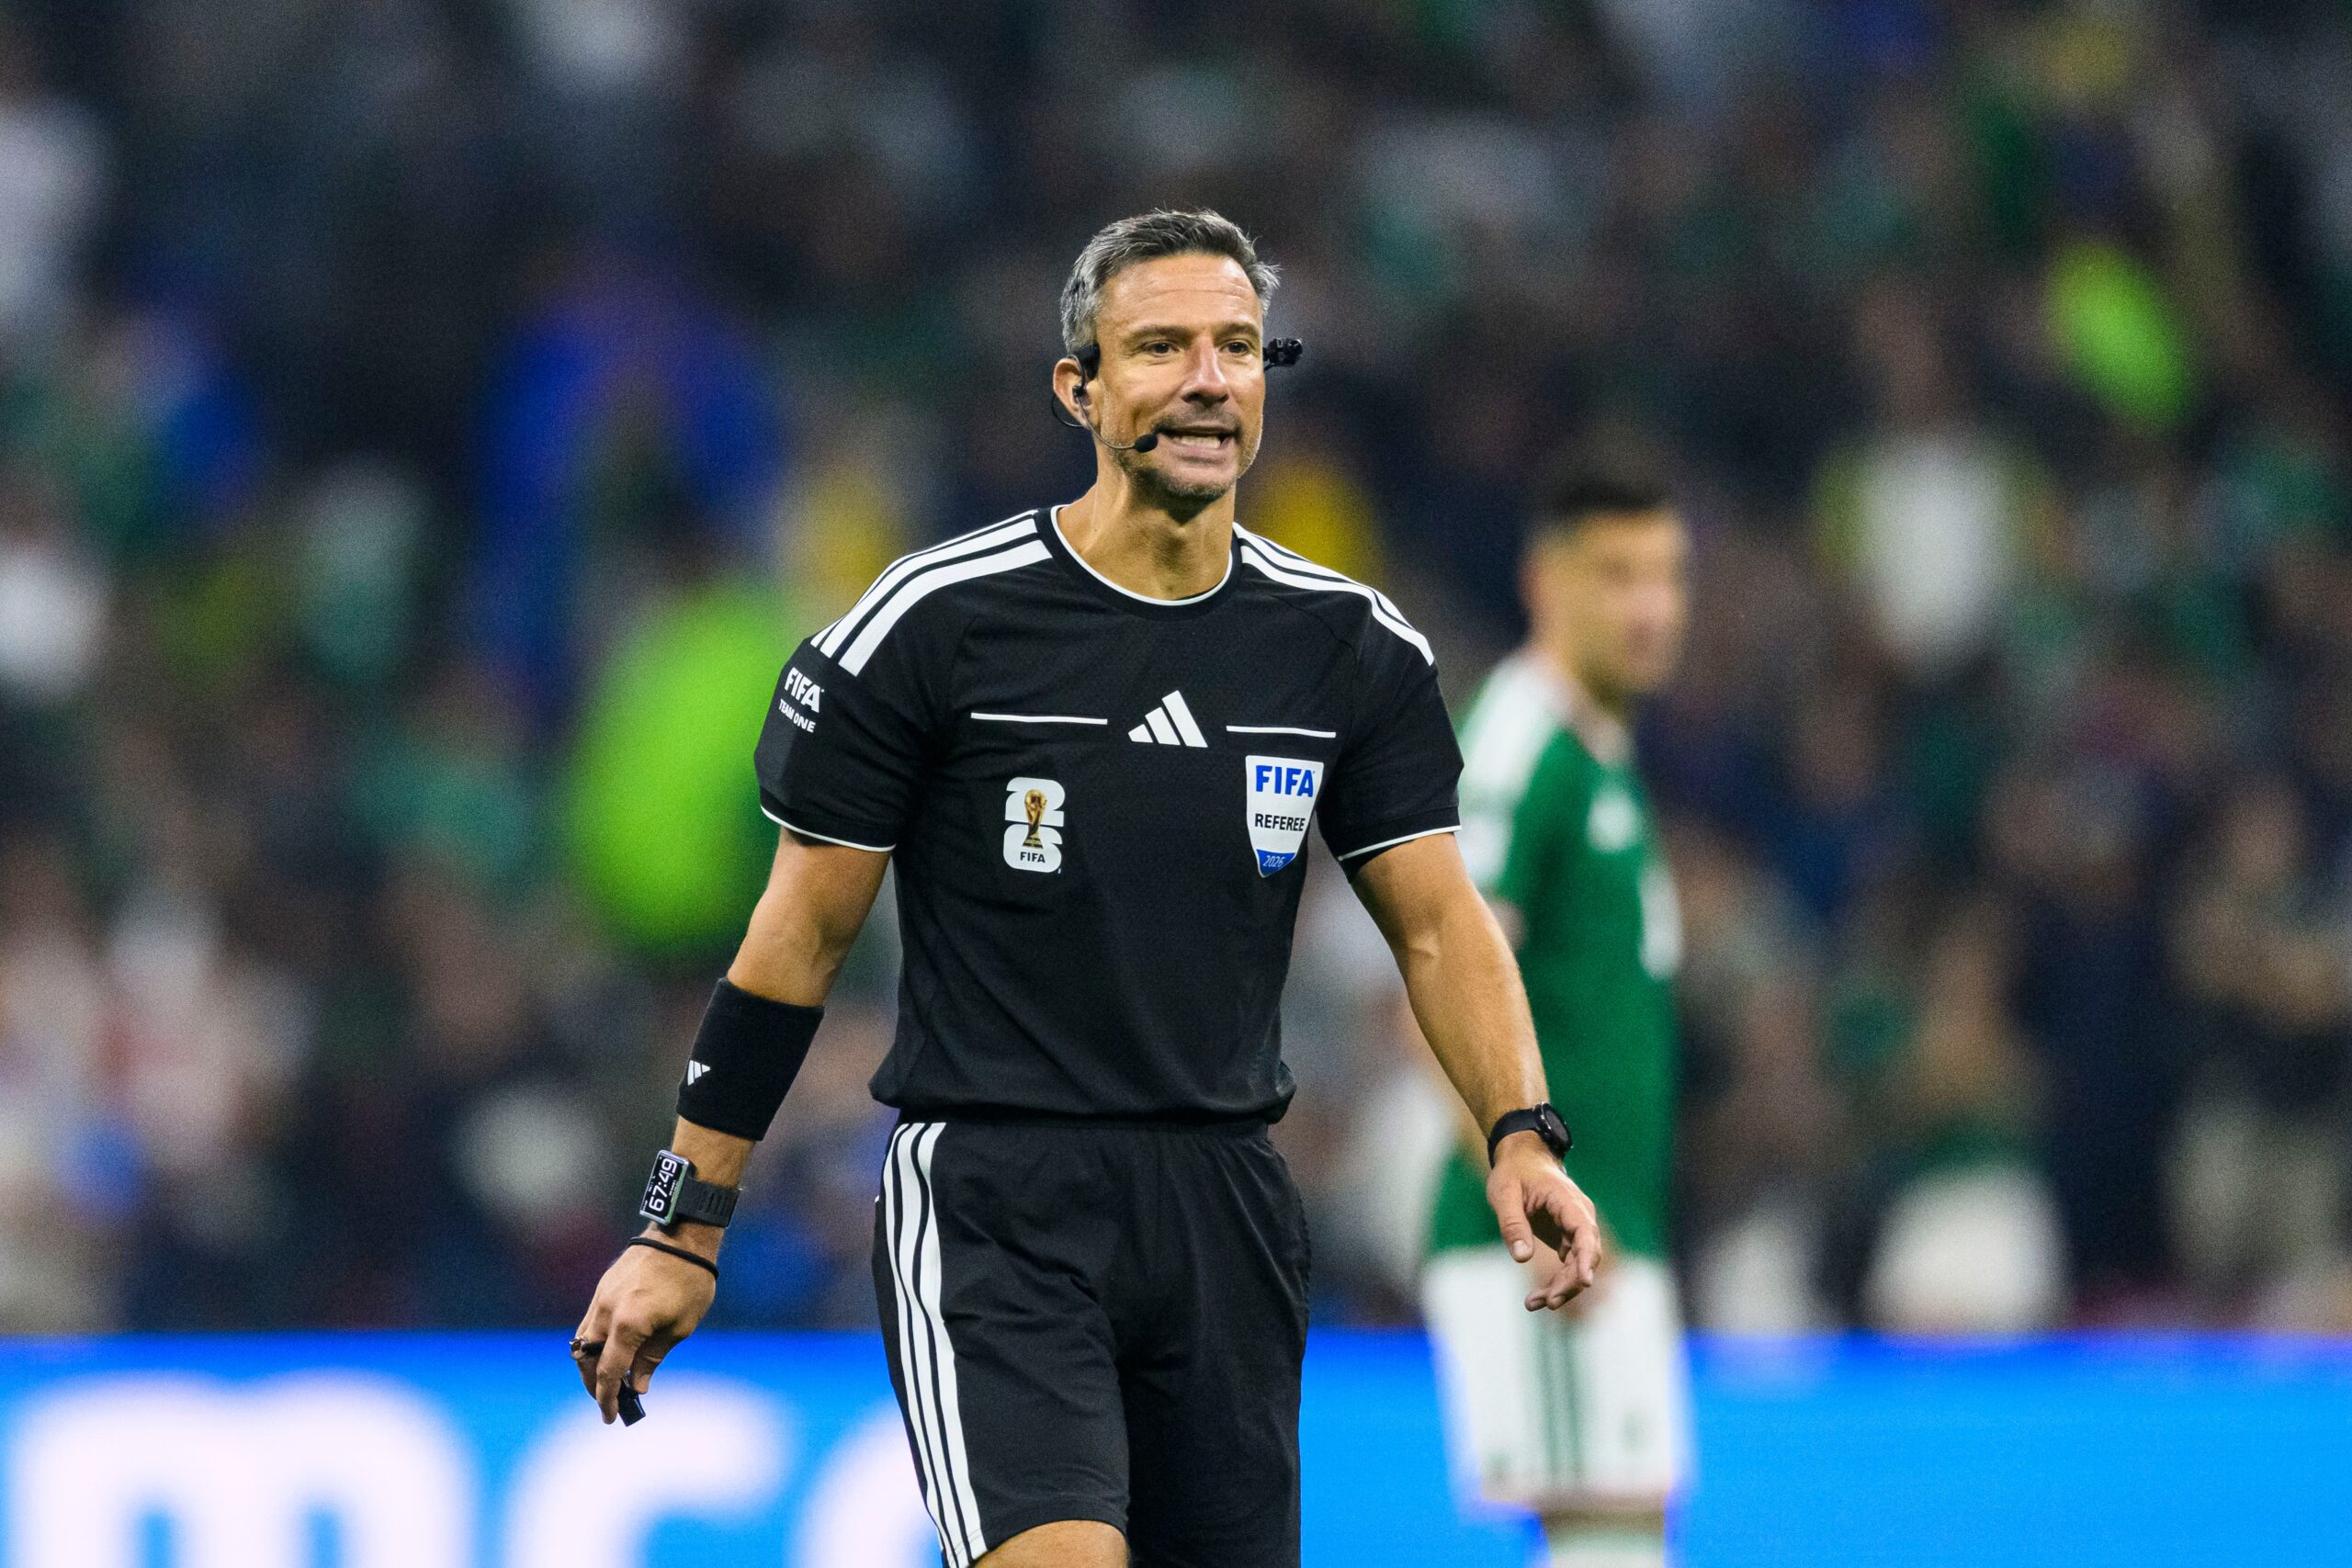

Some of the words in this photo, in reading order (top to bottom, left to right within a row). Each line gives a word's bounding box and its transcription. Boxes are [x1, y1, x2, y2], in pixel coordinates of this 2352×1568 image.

[785, 667, 821, 713] FIFA
[778, 698, 796, 720] TEAM
[793, 712, 816, 733] ONE
[1255, 764, 1314, 798] FIFA
[1254, 812, 1306, 832] REFEREE
[1019, 851, 1046, 863] FIFA
[1262, 854, 1286, 868] 2026
[648, 1157, 678, 1213] 67:49
